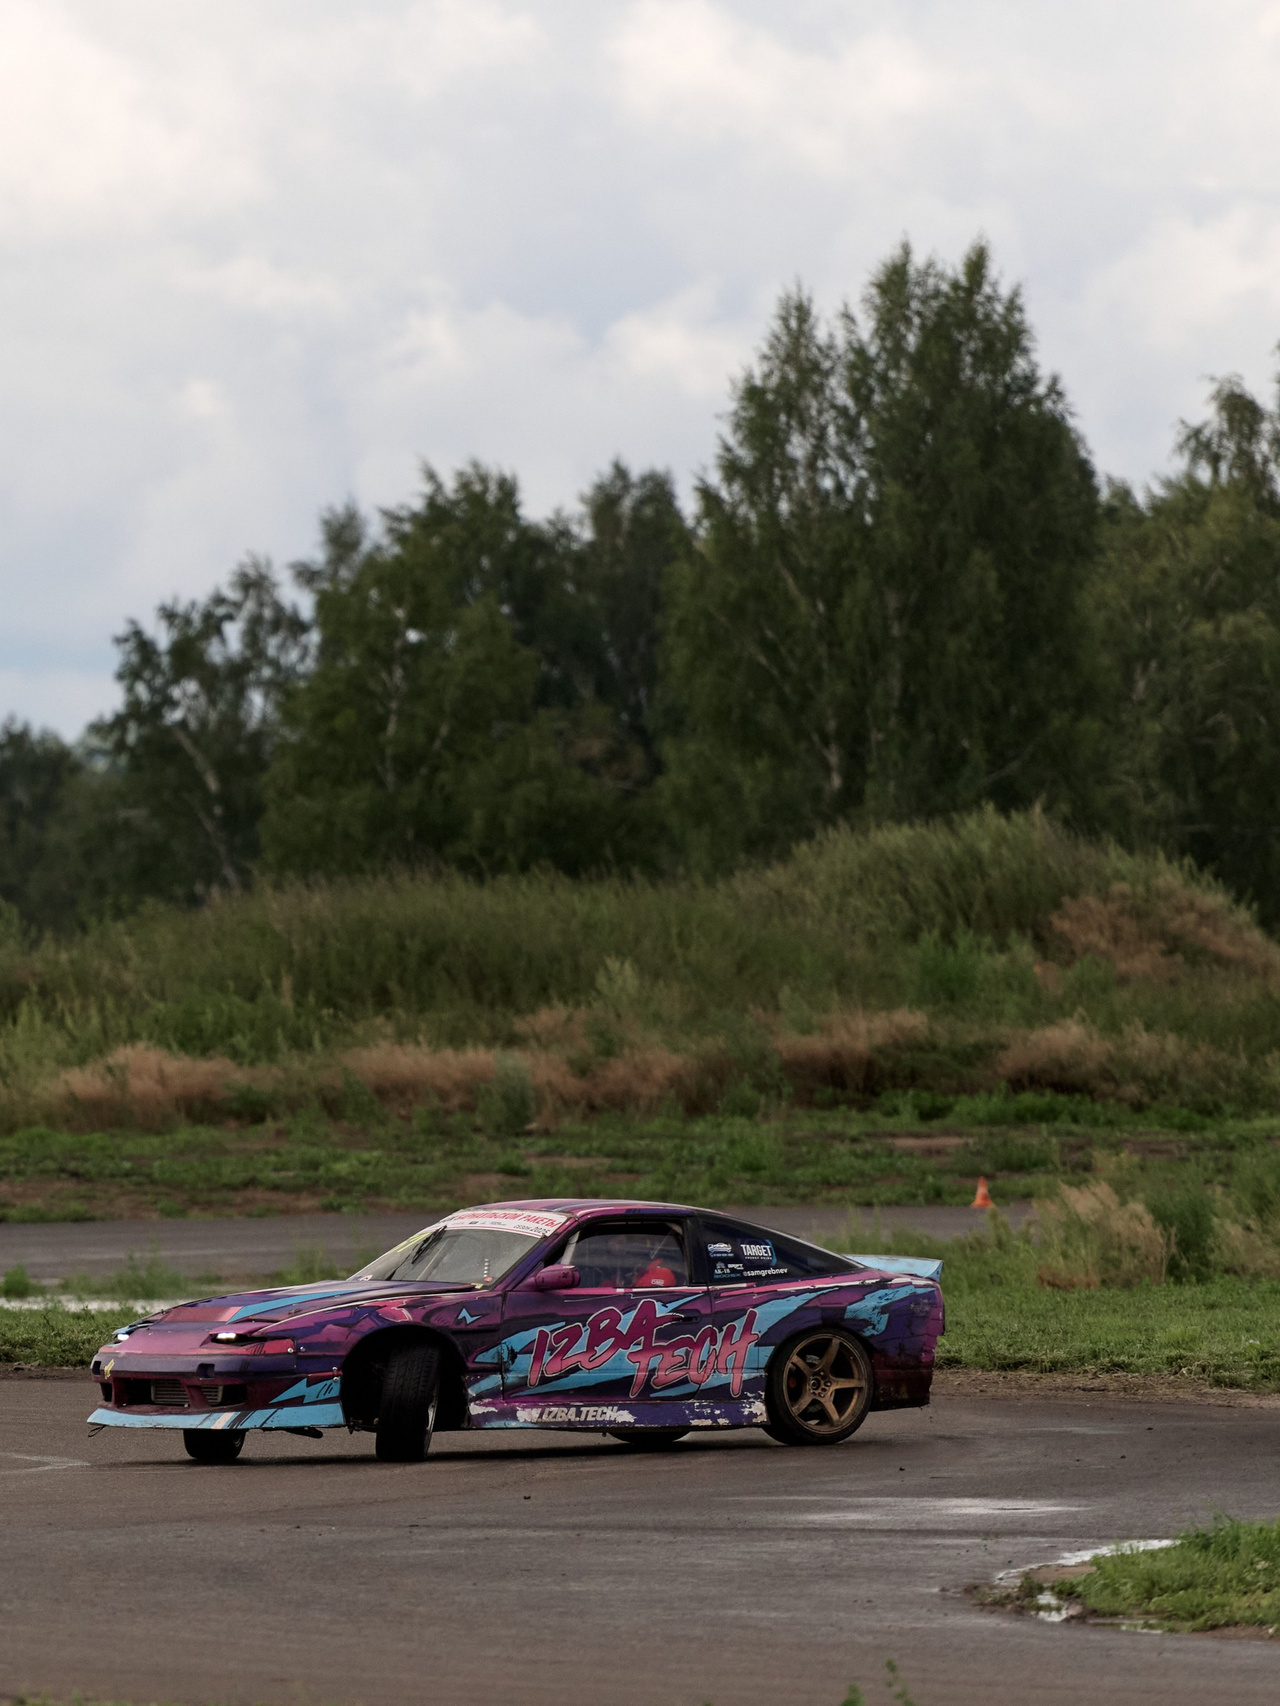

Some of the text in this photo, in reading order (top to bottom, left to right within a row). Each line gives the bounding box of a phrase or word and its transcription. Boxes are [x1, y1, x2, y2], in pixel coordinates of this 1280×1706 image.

[519, 1214, 562, 1228] РАКЕТЫ
[740, 1244, 772, 1257] TARGET
[742, 1267, 788, 1277] @samgrebnev
[527, 1299, 684, 1388] IZBA
[626, 1308, 759, 1398] TECH
